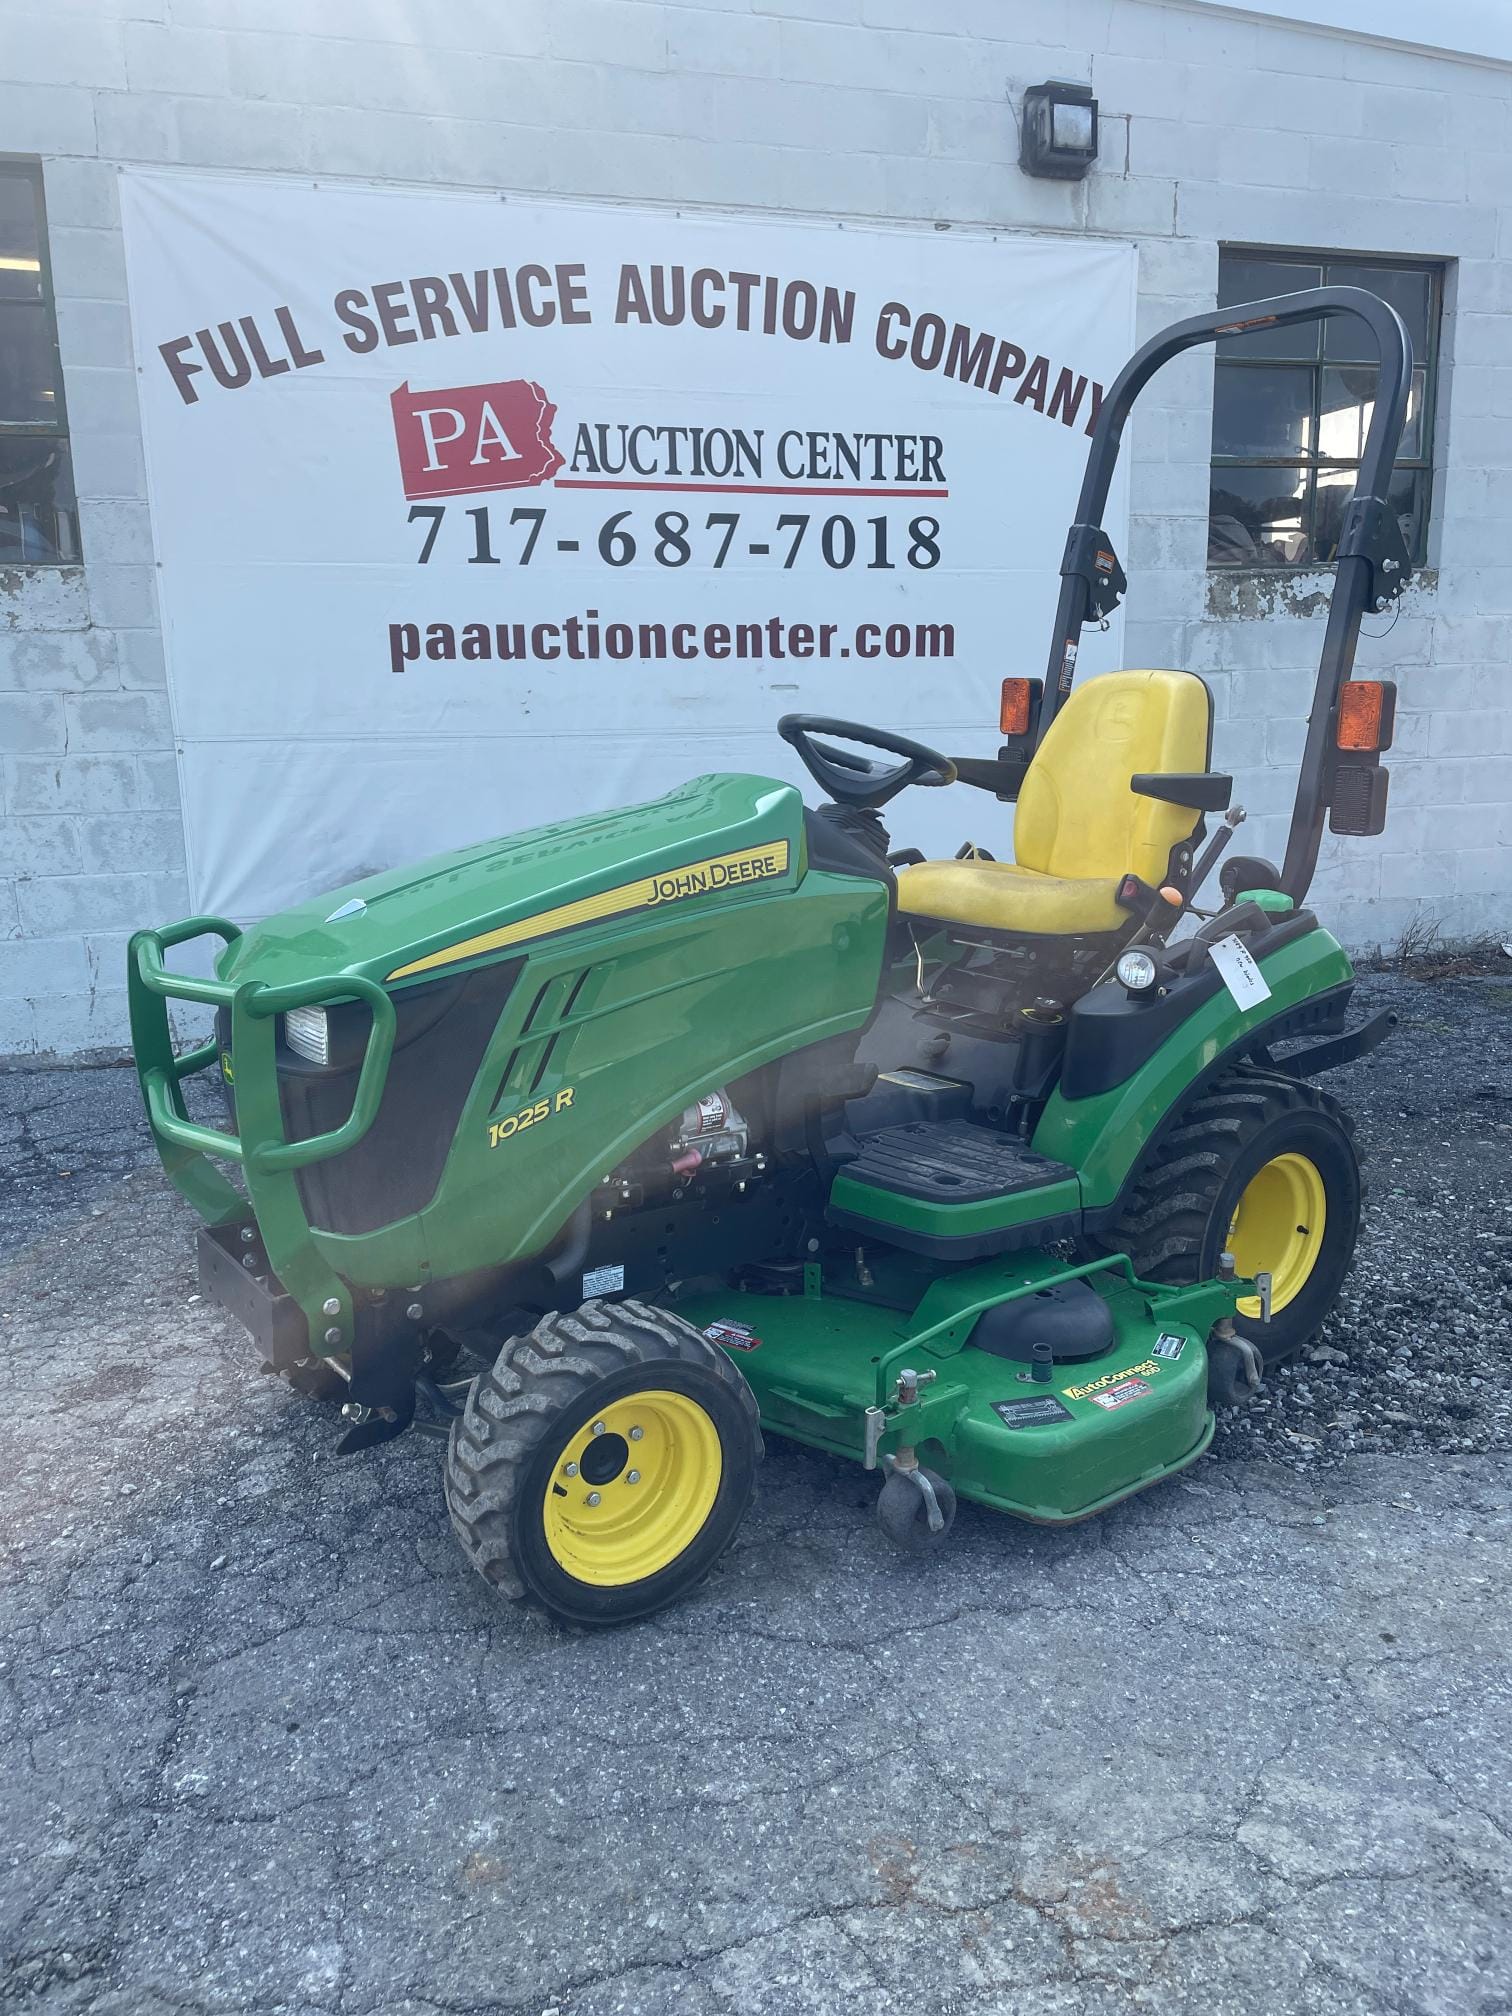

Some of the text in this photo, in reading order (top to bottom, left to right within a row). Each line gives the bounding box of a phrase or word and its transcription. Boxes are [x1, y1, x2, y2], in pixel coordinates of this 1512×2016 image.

[158, 306, 325, 405] FULL
[334, 264, 592, 354] SERVICE
[615, 264, 857, 344] AUCTION
[412, 401, 946, 482] PA AUCTION CENTER
[408, 506, 941, 570] 717-687-7018
[389, 610, 955, 672] paauctioncenter.com
[647, 855, 777, 903] JOHN DEERE
[488, 1086, 576, 1149] 1025 R
[1072, 1359, 1159, 1399] AutoConnect
